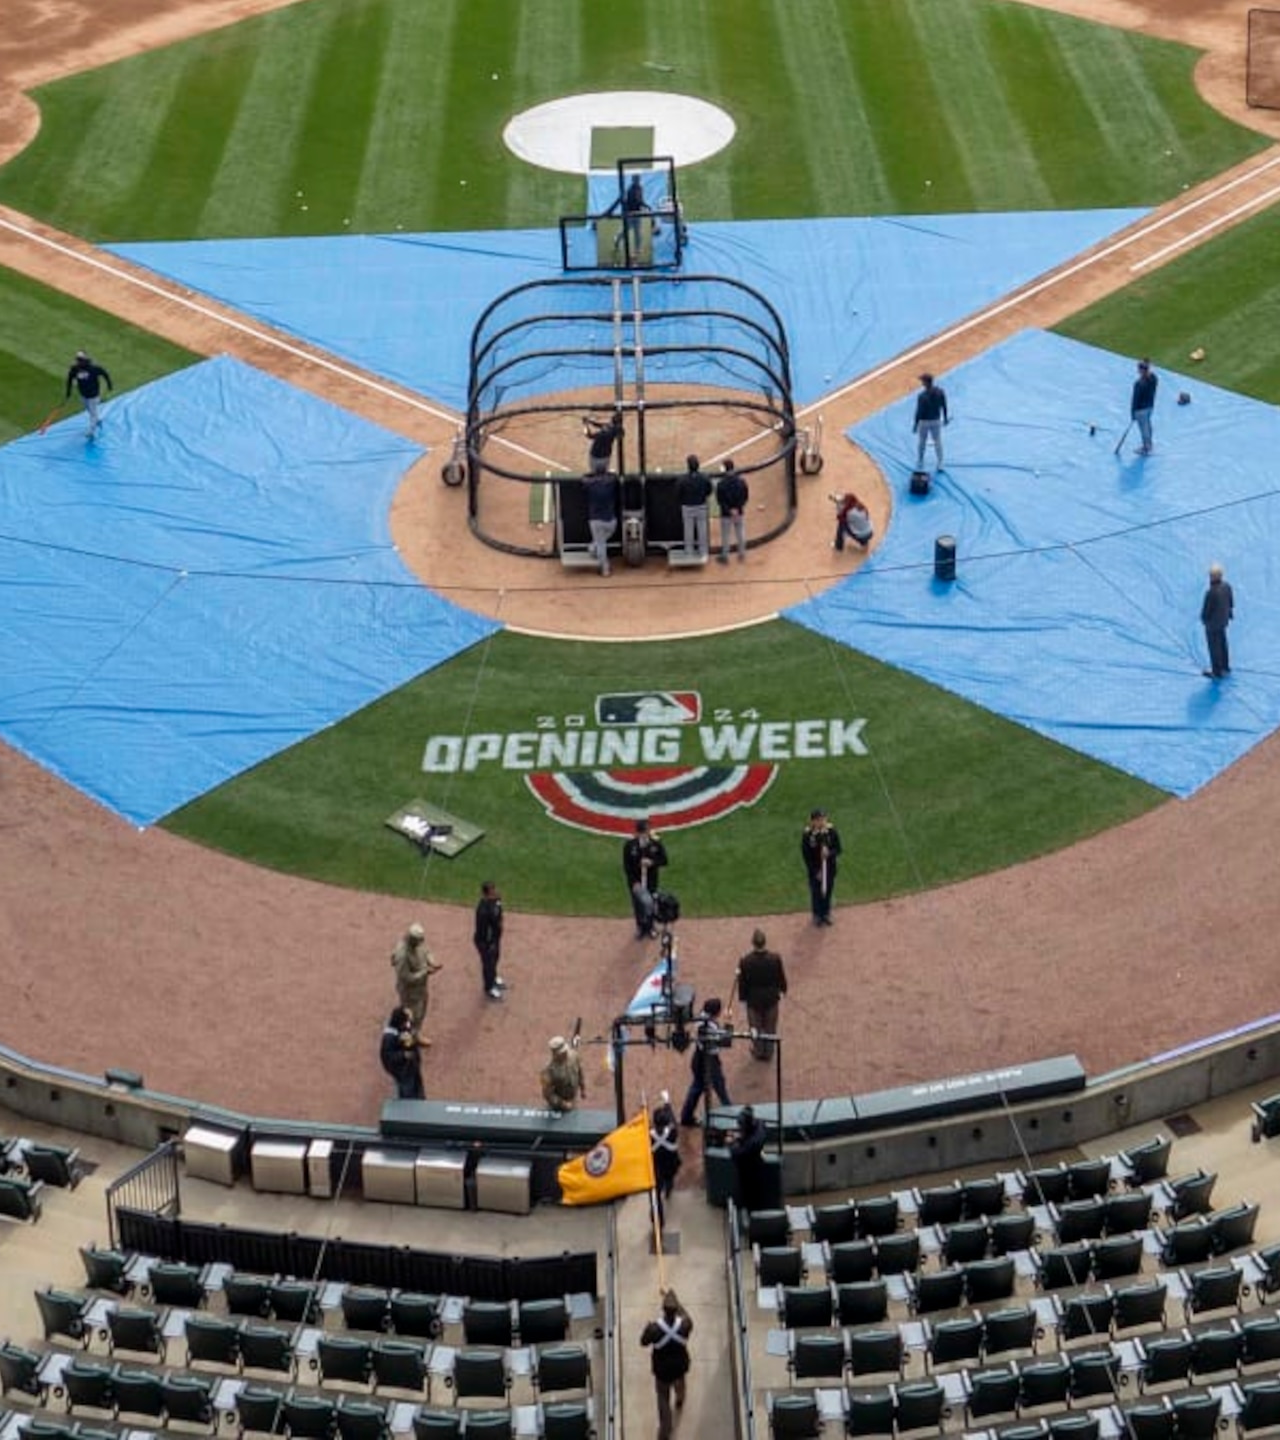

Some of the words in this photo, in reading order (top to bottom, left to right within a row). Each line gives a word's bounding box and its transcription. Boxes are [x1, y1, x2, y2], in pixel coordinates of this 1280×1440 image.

[536, 714, 585, 729] 20
[713, 707, 762, 722] 24
[422, 725, 684, 774] OPENING
[698, 717, 871, 761] WEEK
